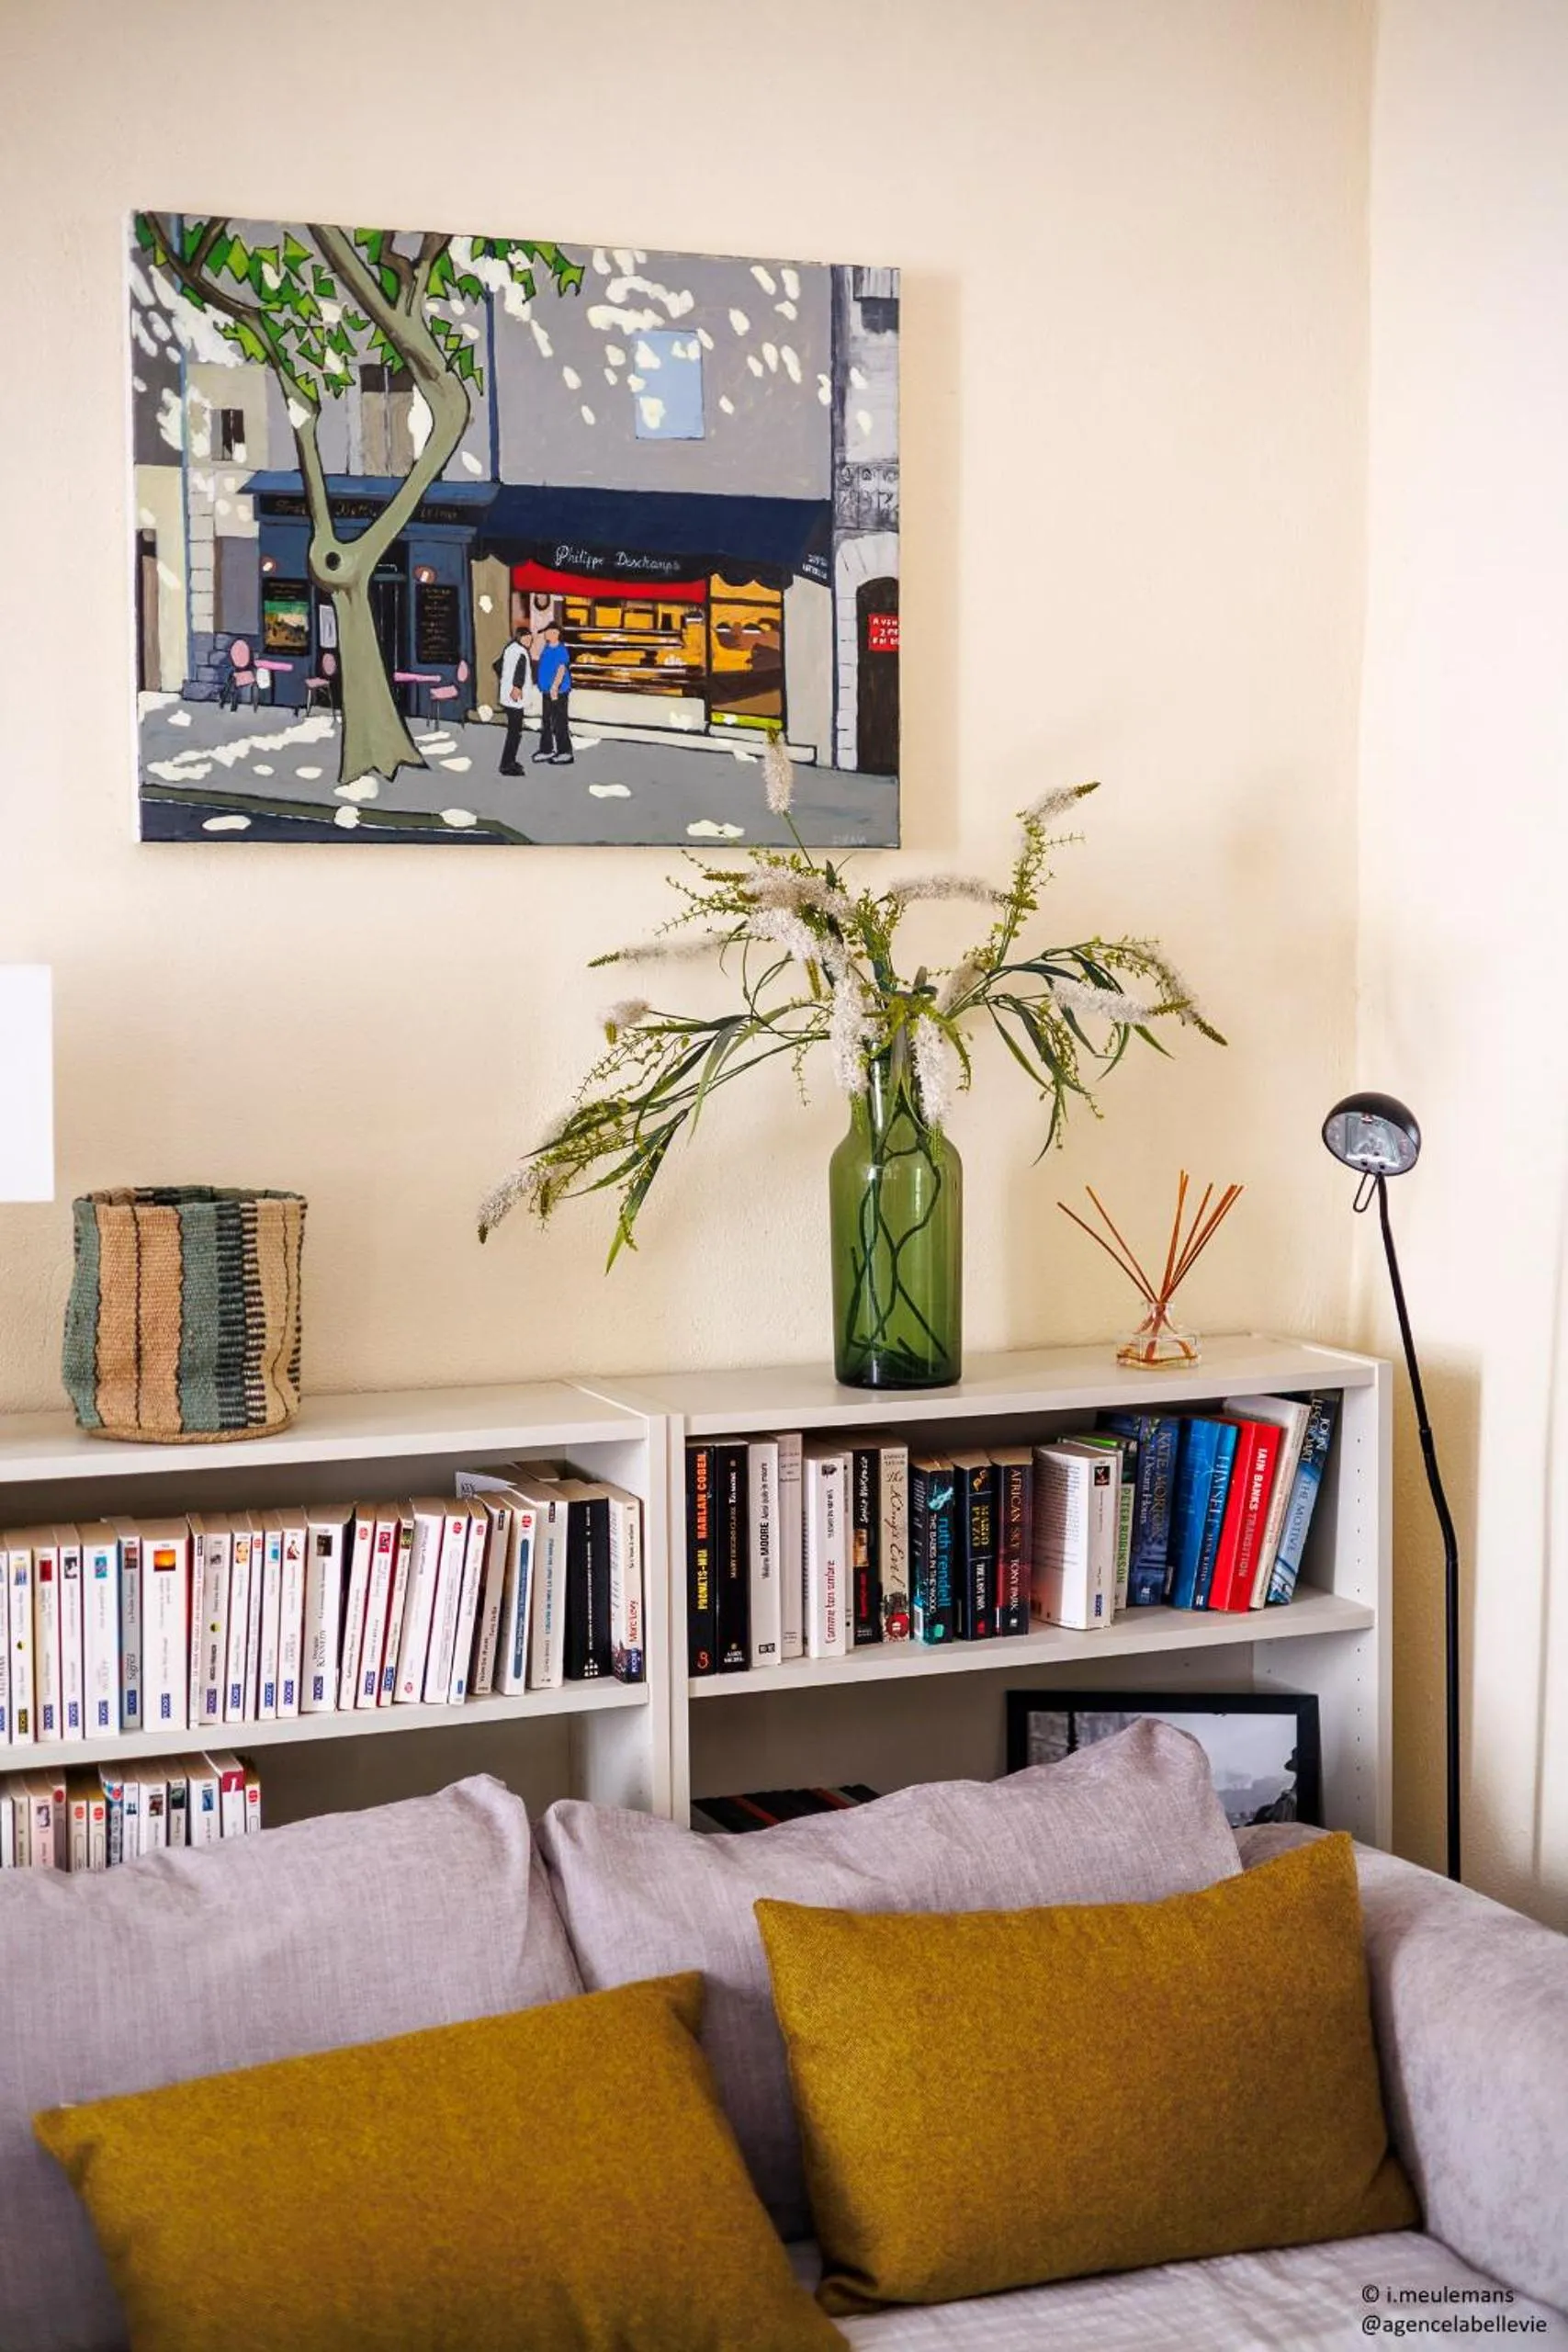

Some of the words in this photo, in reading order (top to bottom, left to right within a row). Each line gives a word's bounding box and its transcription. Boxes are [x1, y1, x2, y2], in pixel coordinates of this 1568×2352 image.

[1158, 1430, 1172, 1469] KATE
[1255, 1447, 1269, 1472] IAIN
[696, 1452, 707, 1490] COBEN
[1010, 1469, 1022, 1522] AFRICAN
[1118, 1487, 1132, 1521] PETER
[1249, 1474, 1264, 1511] BANKS
[696, 1494, 708, 1539] HARLAN
[937, 1516, 951, 1549] ruth
[1287, 1504, 1306, 1555] MOTIVE
[759, 1521, 769, 1556] MOORE
[1116, 1523, 1131, 1585] ROBINSON
[1237, 1512, 1256, 1578] TRANSITION
[937, 1554, 952, 1608] rendell
[1010, 1558, 1021, 1585] TONY
[628, 1600, 638, 1620] Levy
[628, 1621, 637, 1643] Marc
